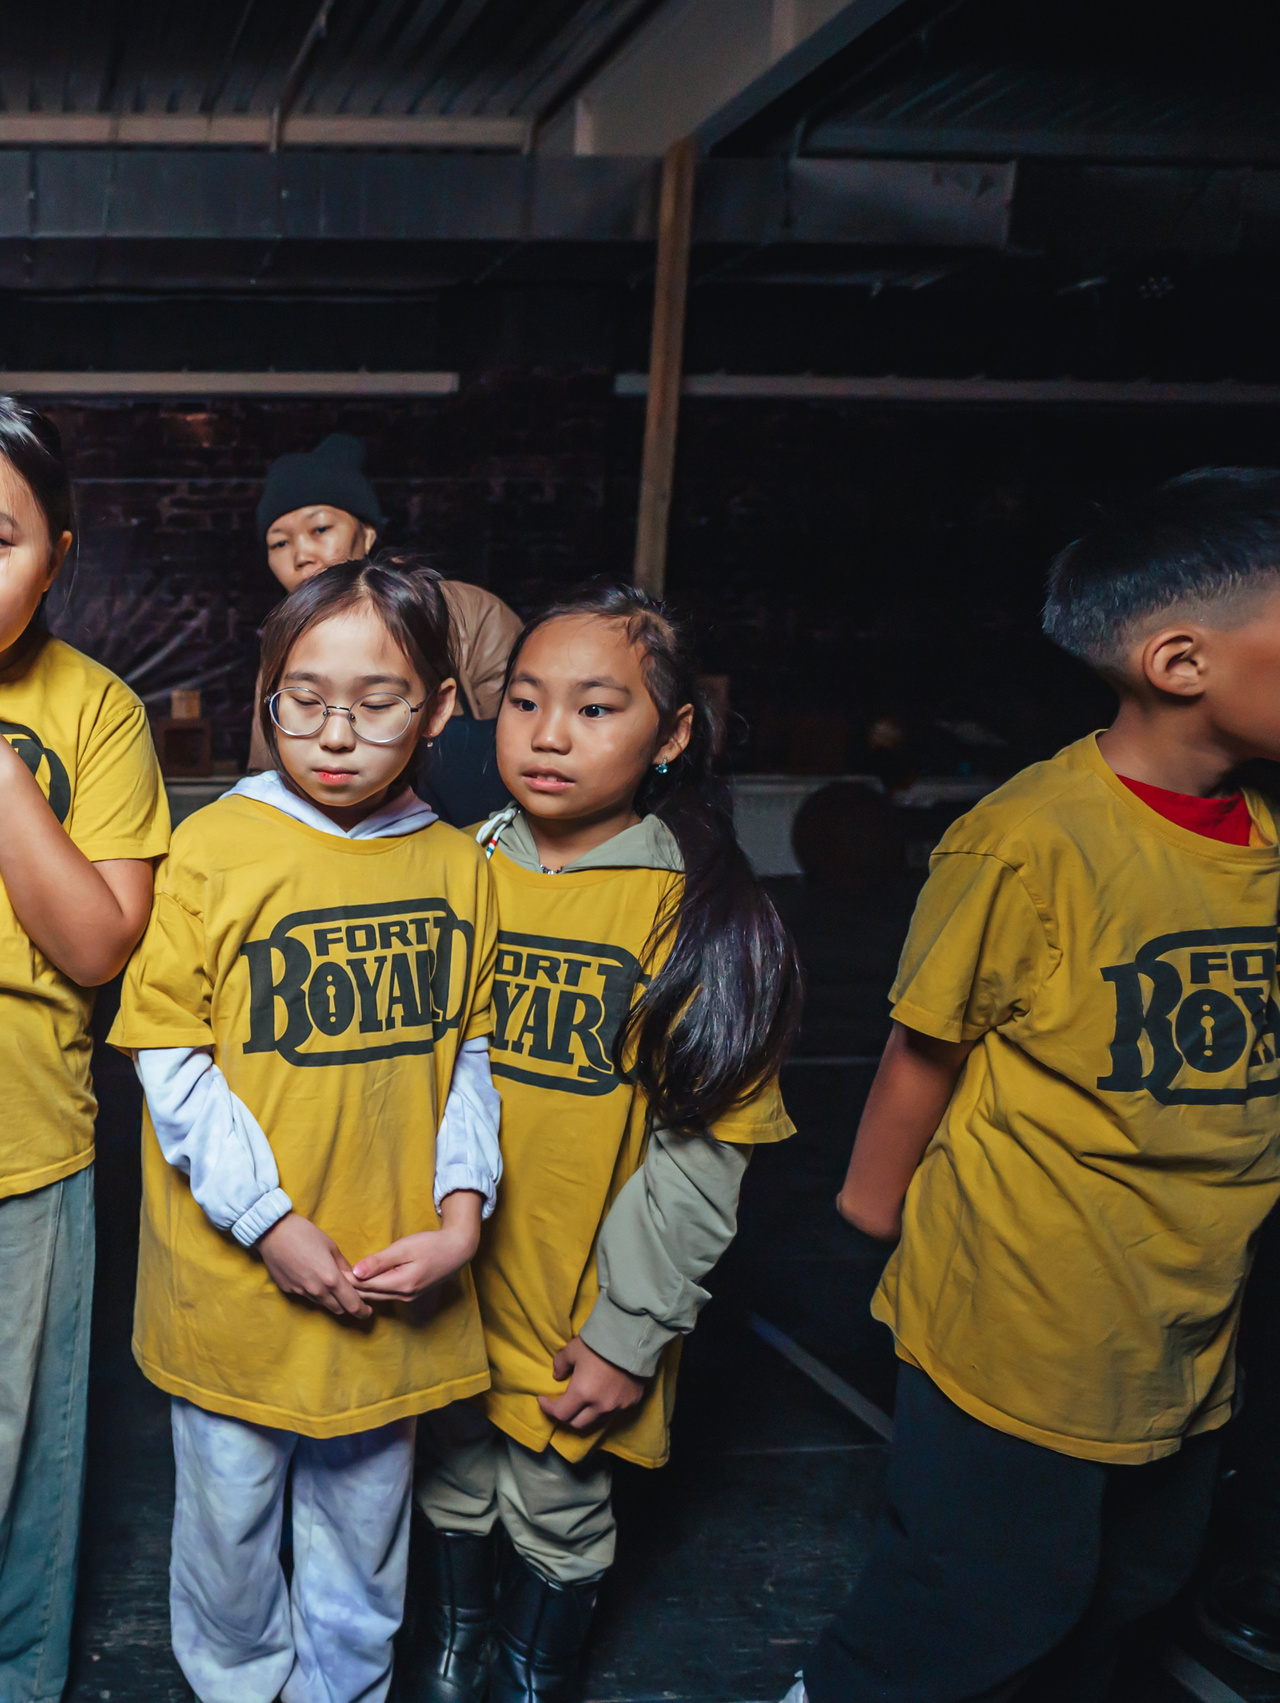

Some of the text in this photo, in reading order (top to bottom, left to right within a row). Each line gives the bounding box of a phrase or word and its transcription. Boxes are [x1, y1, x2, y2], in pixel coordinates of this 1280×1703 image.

[313, 917, 430, 956] FORT
[240, 917, 474, 1054] BOYARD
[494, 950, 592, 987] ORT
[1190, 949, 1277, 984] FO
